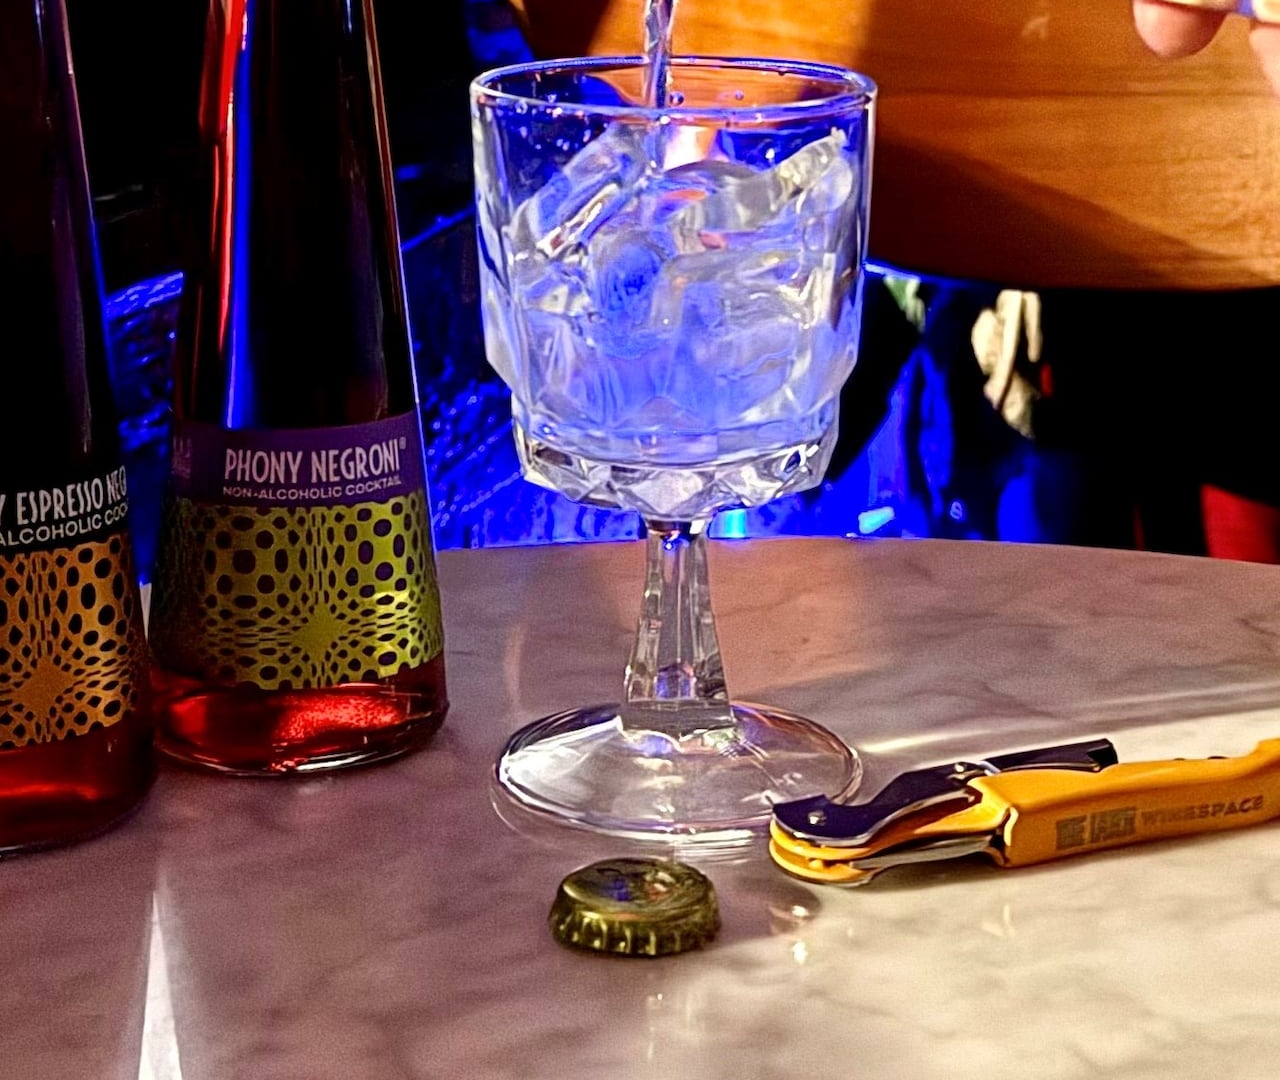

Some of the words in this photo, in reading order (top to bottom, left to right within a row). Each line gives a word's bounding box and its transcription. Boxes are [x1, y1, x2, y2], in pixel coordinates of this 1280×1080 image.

[223, 447, 304, 485] PHONY
[16, 478, 104, 524] ESPRESSO
[223, 485, 342, 501] NON-ALCOHOLIC
[344, 473, 403, 497] COCKTAIL
